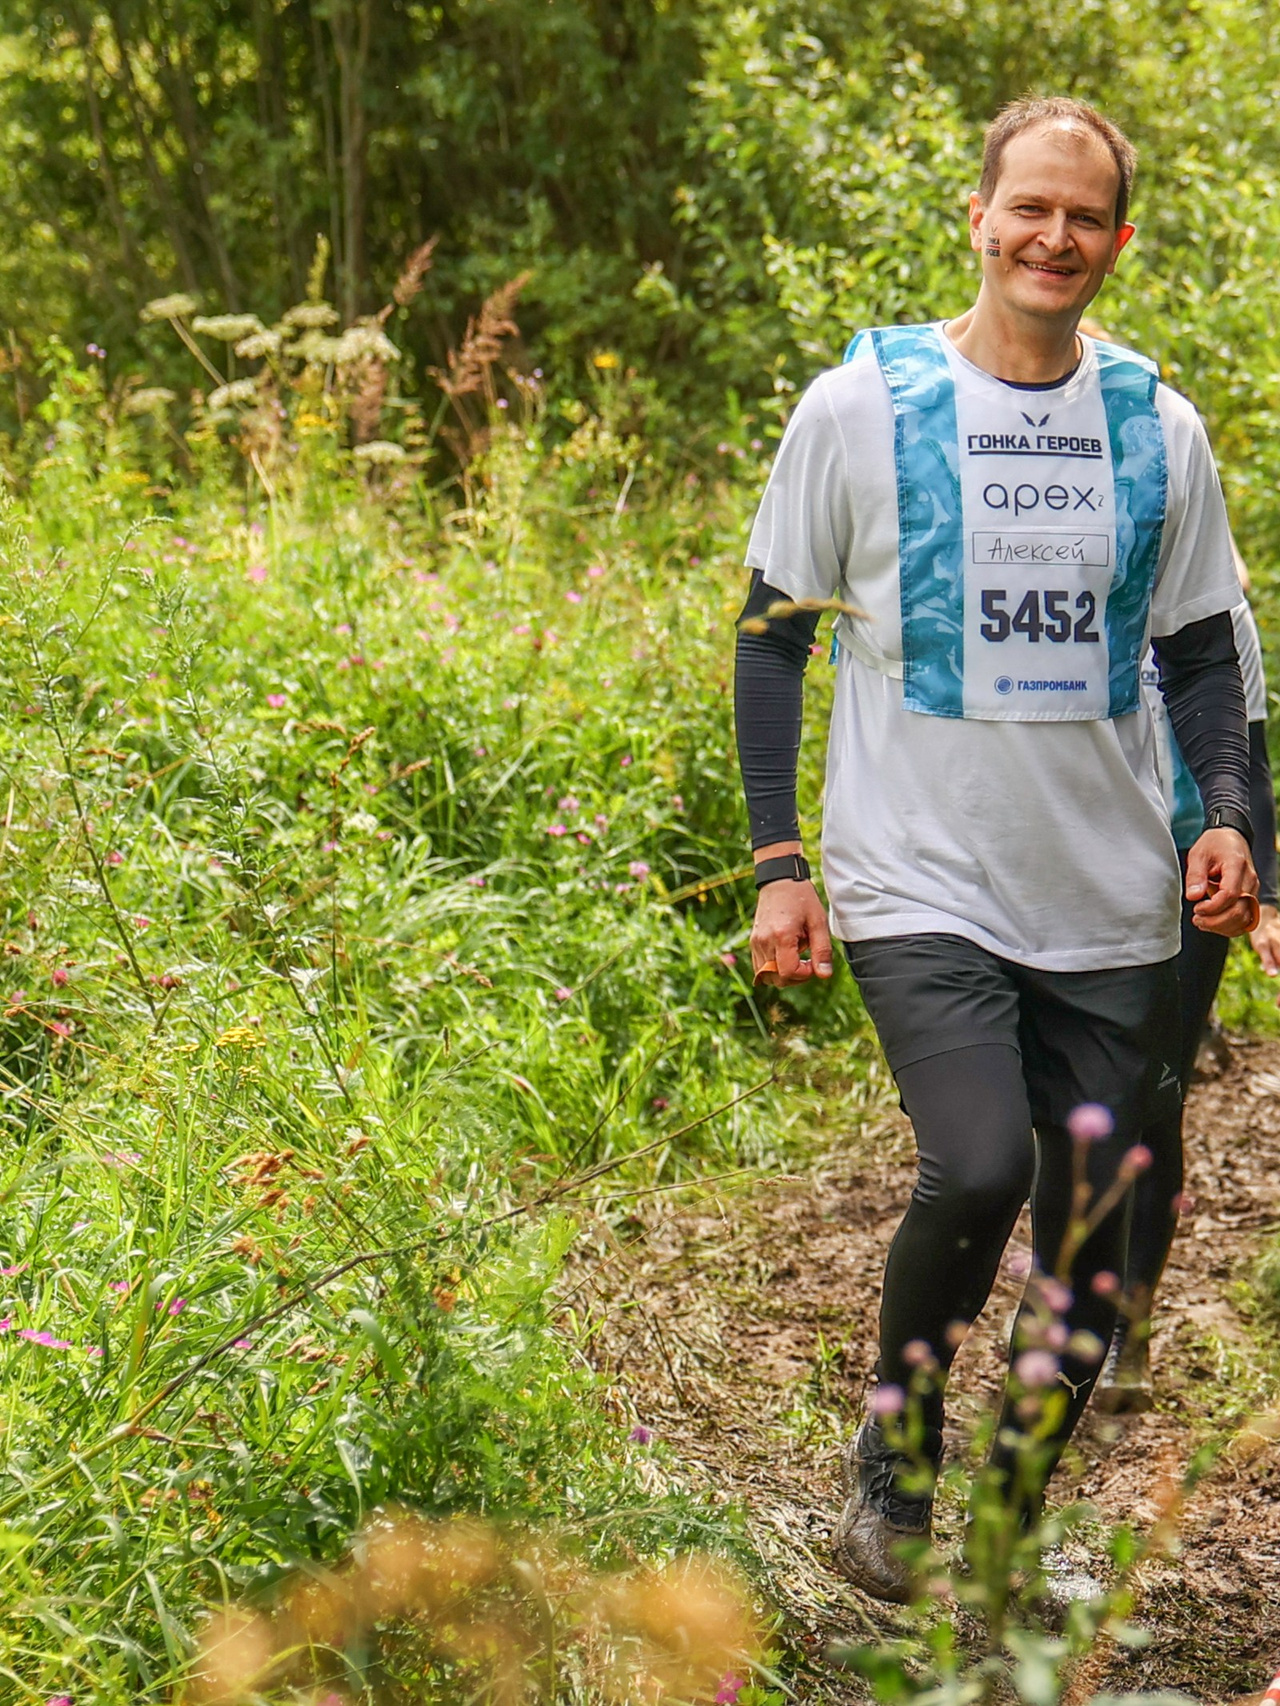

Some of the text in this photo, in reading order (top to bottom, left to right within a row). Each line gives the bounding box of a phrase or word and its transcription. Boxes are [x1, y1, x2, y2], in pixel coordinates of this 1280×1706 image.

[968, 434, 1102, 453] ГОНКА ГЕРОЕВ
[983, 483, 1096, 516] apex
[988, 536, 1086, 562] Алексей
[980, 589, 1100, 644] 5452
[1017, 679, 1088, 692] ГАЗПРОМБАНК
